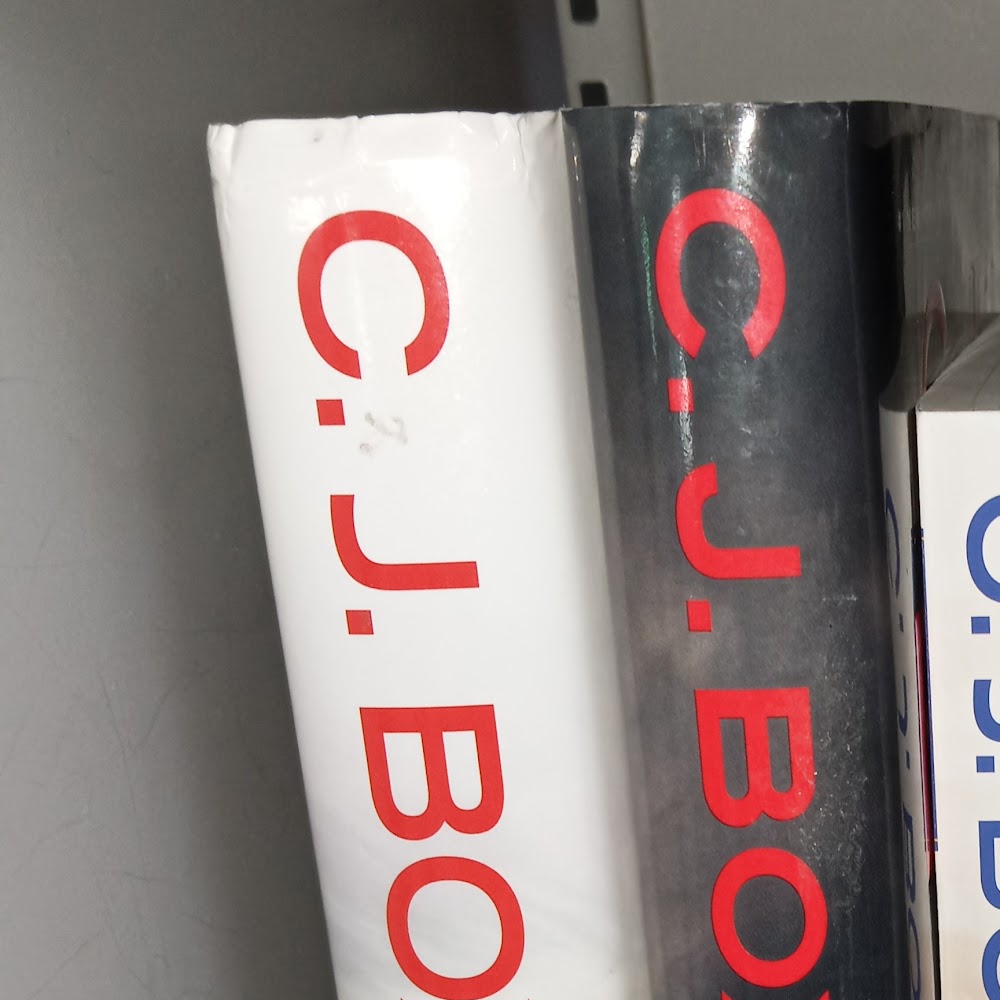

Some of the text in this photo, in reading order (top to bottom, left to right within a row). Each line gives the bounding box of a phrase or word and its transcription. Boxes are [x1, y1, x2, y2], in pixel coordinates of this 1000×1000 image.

[297, 209, 450, 427] C.
[655, 187, 787, 413] C.
[330, 494, 480, 636] J.
[674, 461, 802, 633] J.
